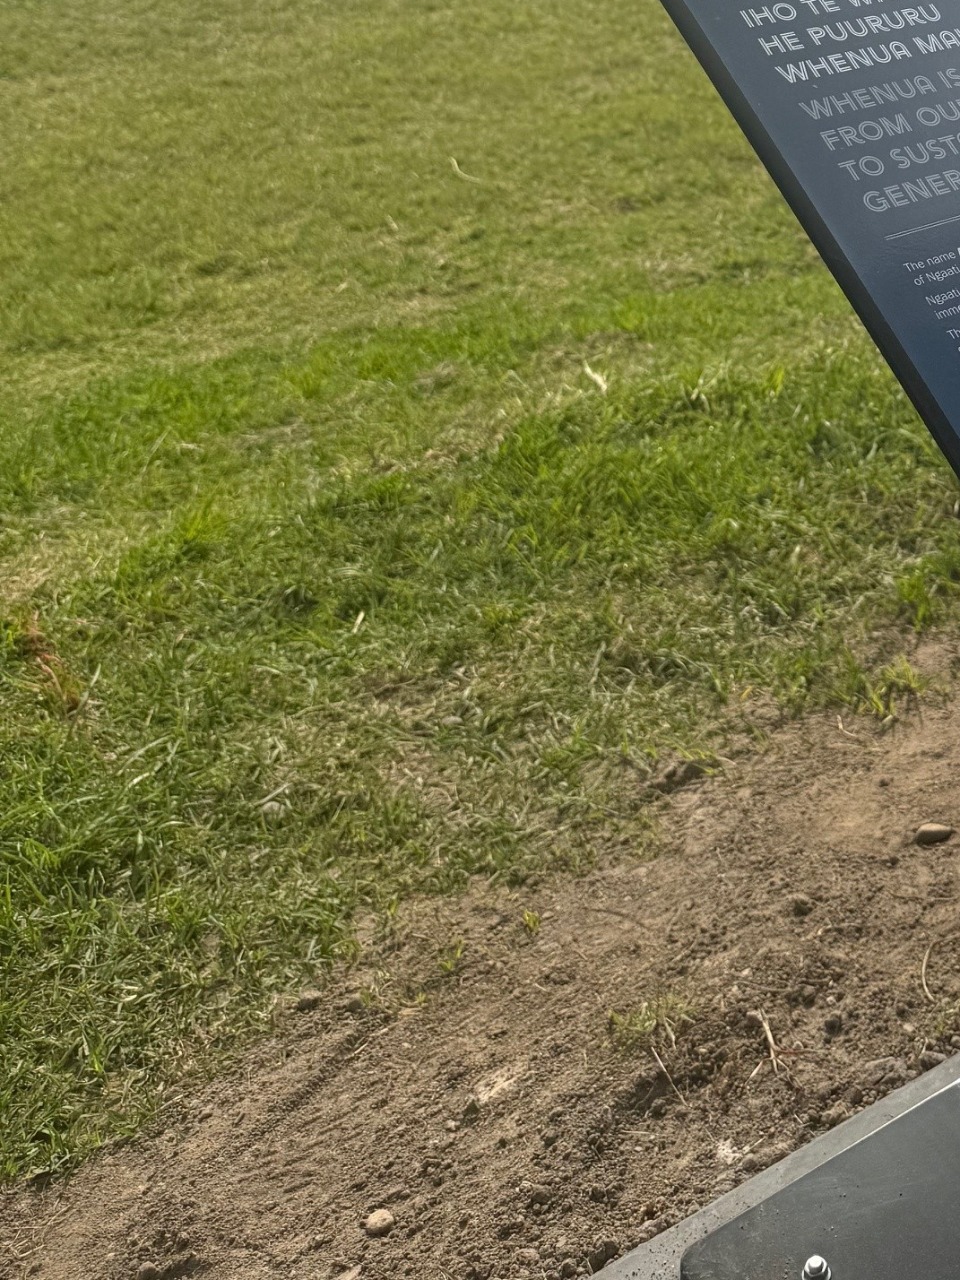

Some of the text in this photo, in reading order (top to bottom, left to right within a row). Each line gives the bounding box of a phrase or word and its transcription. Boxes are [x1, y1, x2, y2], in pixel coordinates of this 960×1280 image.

[739, 2, 797, 28] IHO
[758, 3, 941, 56] HE PUURURU
[774, 41, 912, 84] WHENUA
[798, 75, 937, 120] WHENUA
[819, 113, 913, 151] FROM
[837, 155, 885, 181] TO
[903, 261, 925, 272] The
[926, 252, 956, 266] name
[914, 274, 925, 286] of
[925, 264, 960, 282] Ngaati
[925, 289, 960, 306] Ngaati
